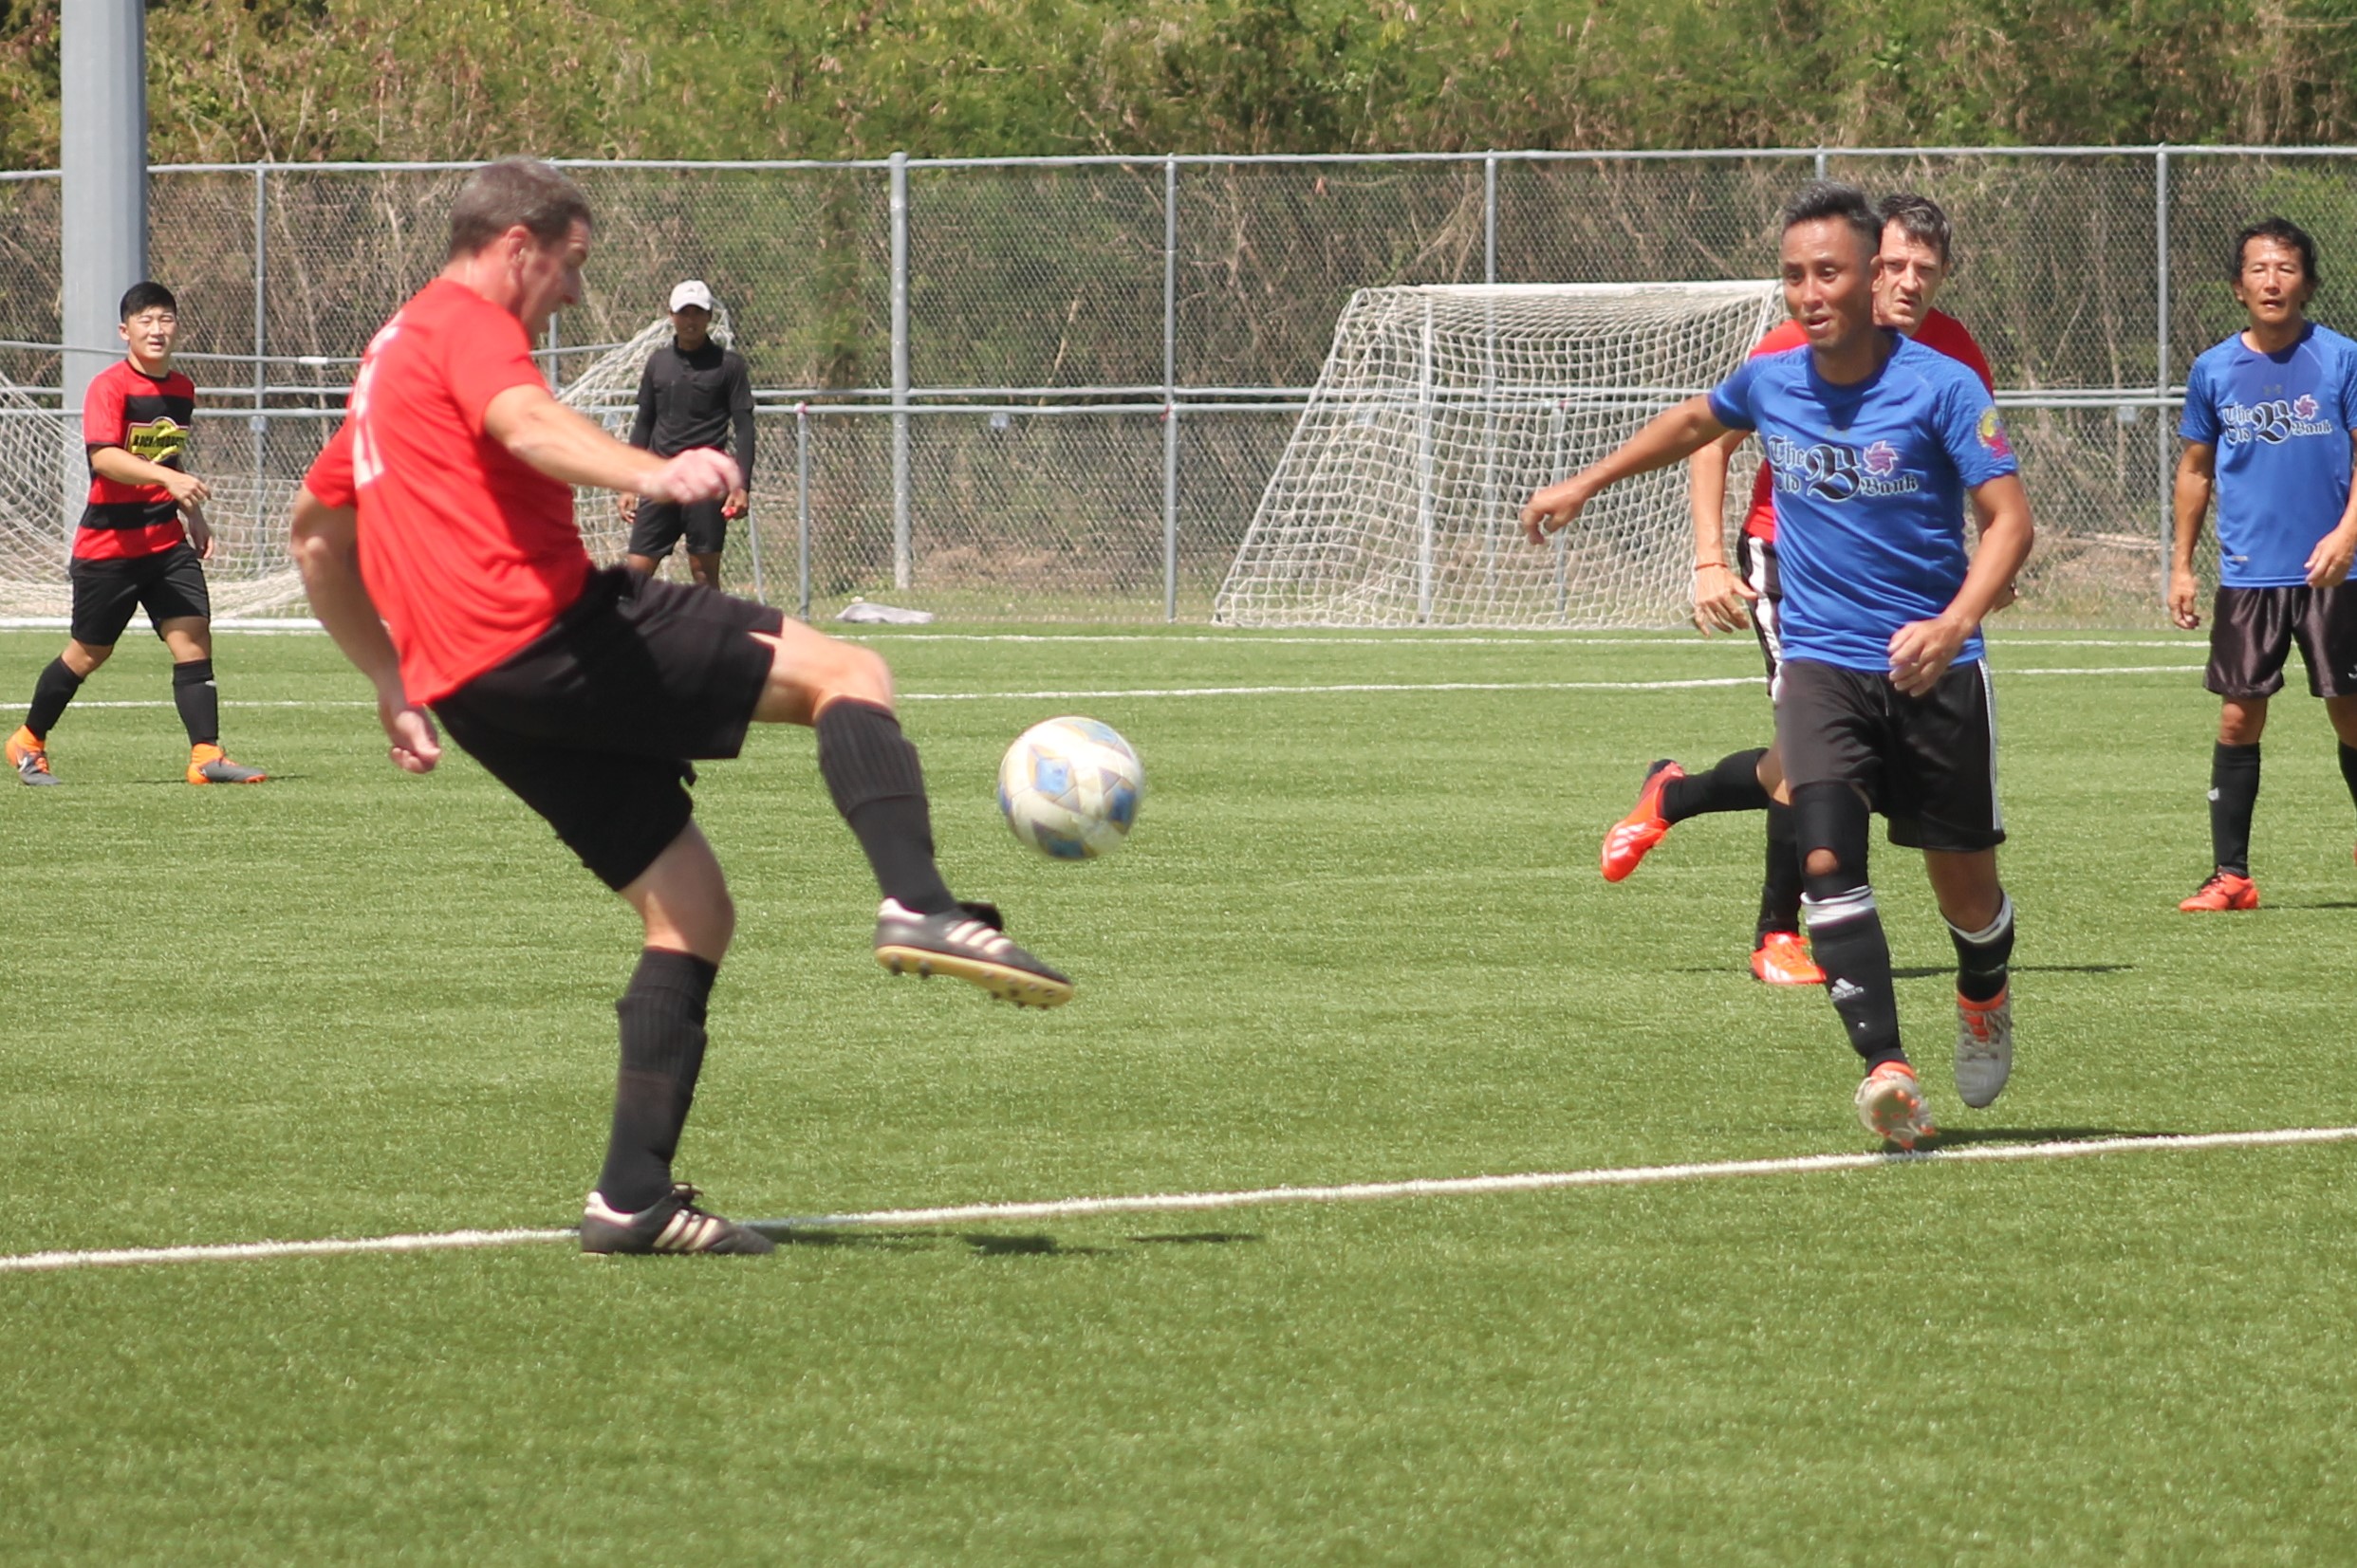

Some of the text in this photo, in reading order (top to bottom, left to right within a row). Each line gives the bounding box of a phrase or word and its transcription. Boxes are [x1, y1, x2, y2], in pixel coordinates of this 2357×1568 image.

[2223, 402, 2253, 426] The
[2291, 419, 2331, 436] Bank
[1768, 434, 1805, 470] The
[1860, 474, 1919, 497] Bank
